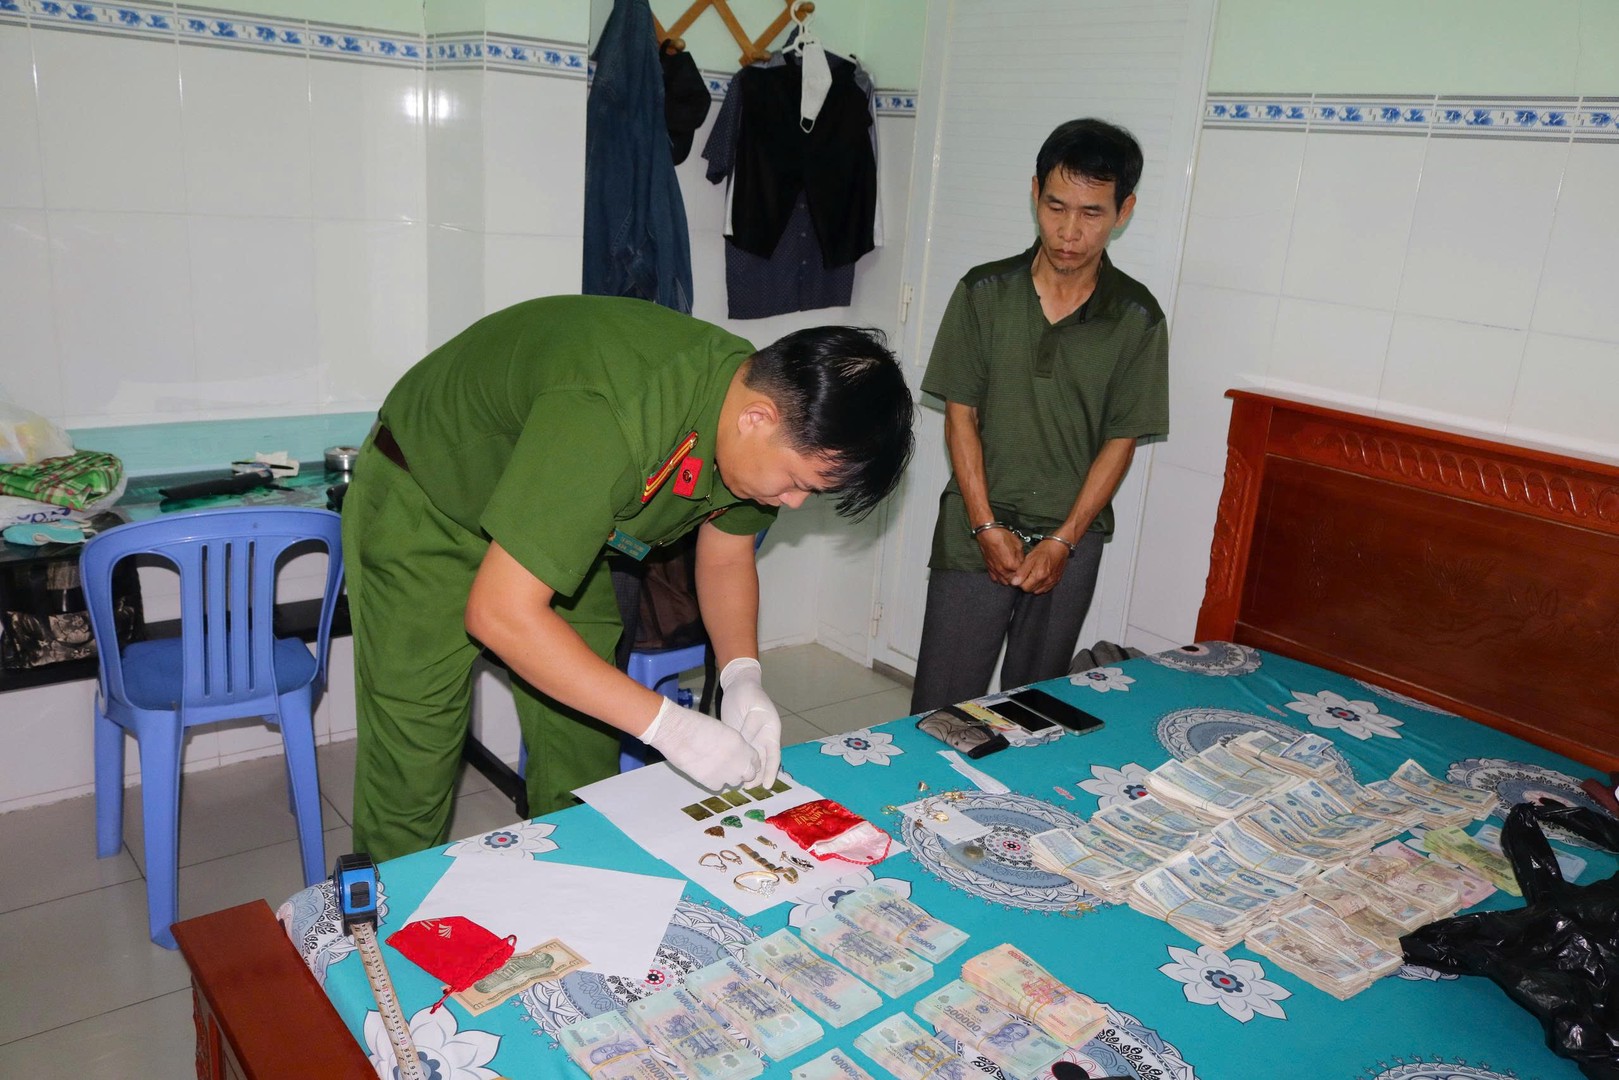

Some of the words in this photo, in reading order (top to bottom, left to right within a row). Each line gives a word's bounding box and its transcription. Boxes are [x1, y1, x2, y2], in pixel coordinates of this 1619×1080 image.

[908, 933, 936, 951] 500000
[673, 991, 699, 1015] 500000
[811, 989, 841, 1010] 500000
[944, 1005, 981, 1031] 500000
